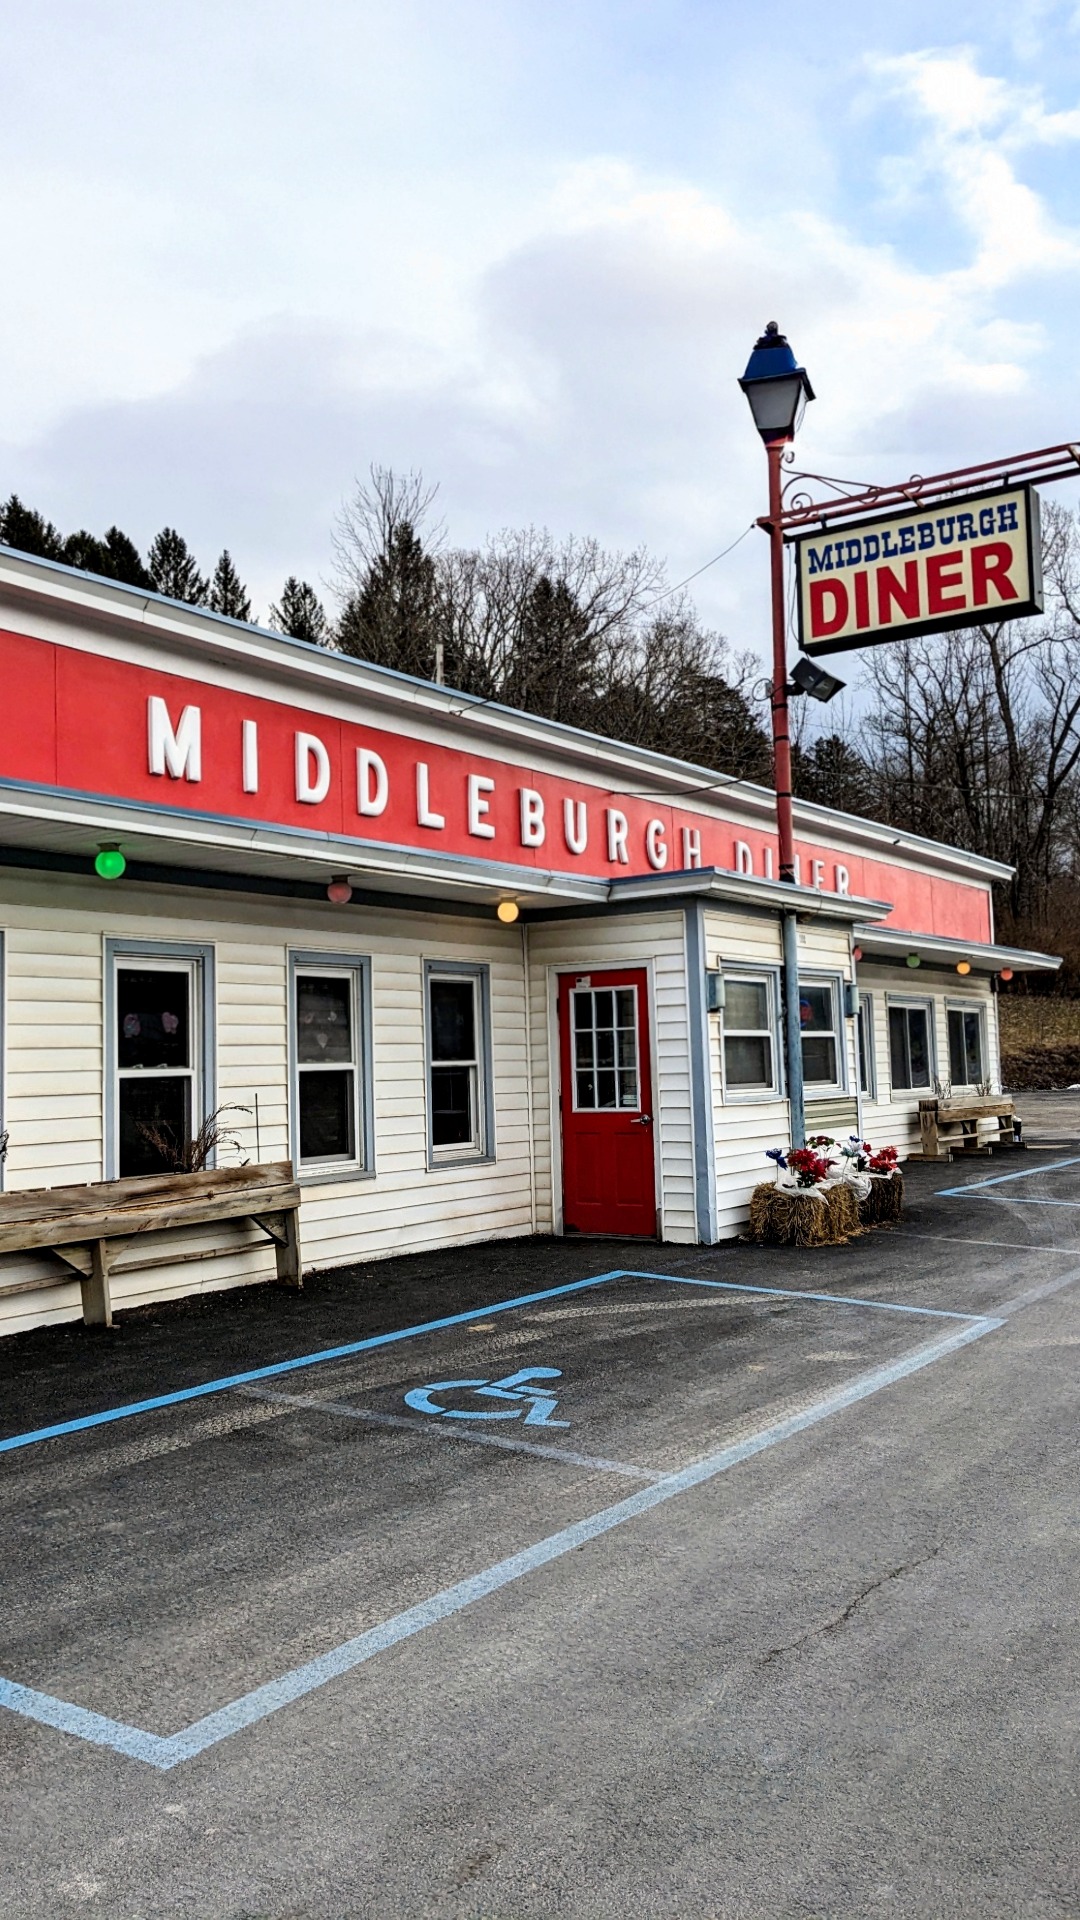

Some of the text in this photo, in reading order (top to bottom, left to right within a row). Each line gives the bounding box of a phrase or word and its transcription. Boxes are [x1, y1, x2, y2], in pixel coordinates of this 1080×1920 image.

[808, 502, 1018, 574] MIDDLEBURGH
[809, 541, 1019, 639] DINER
[147, 695, 701, 870] MIDDLEBURGH
